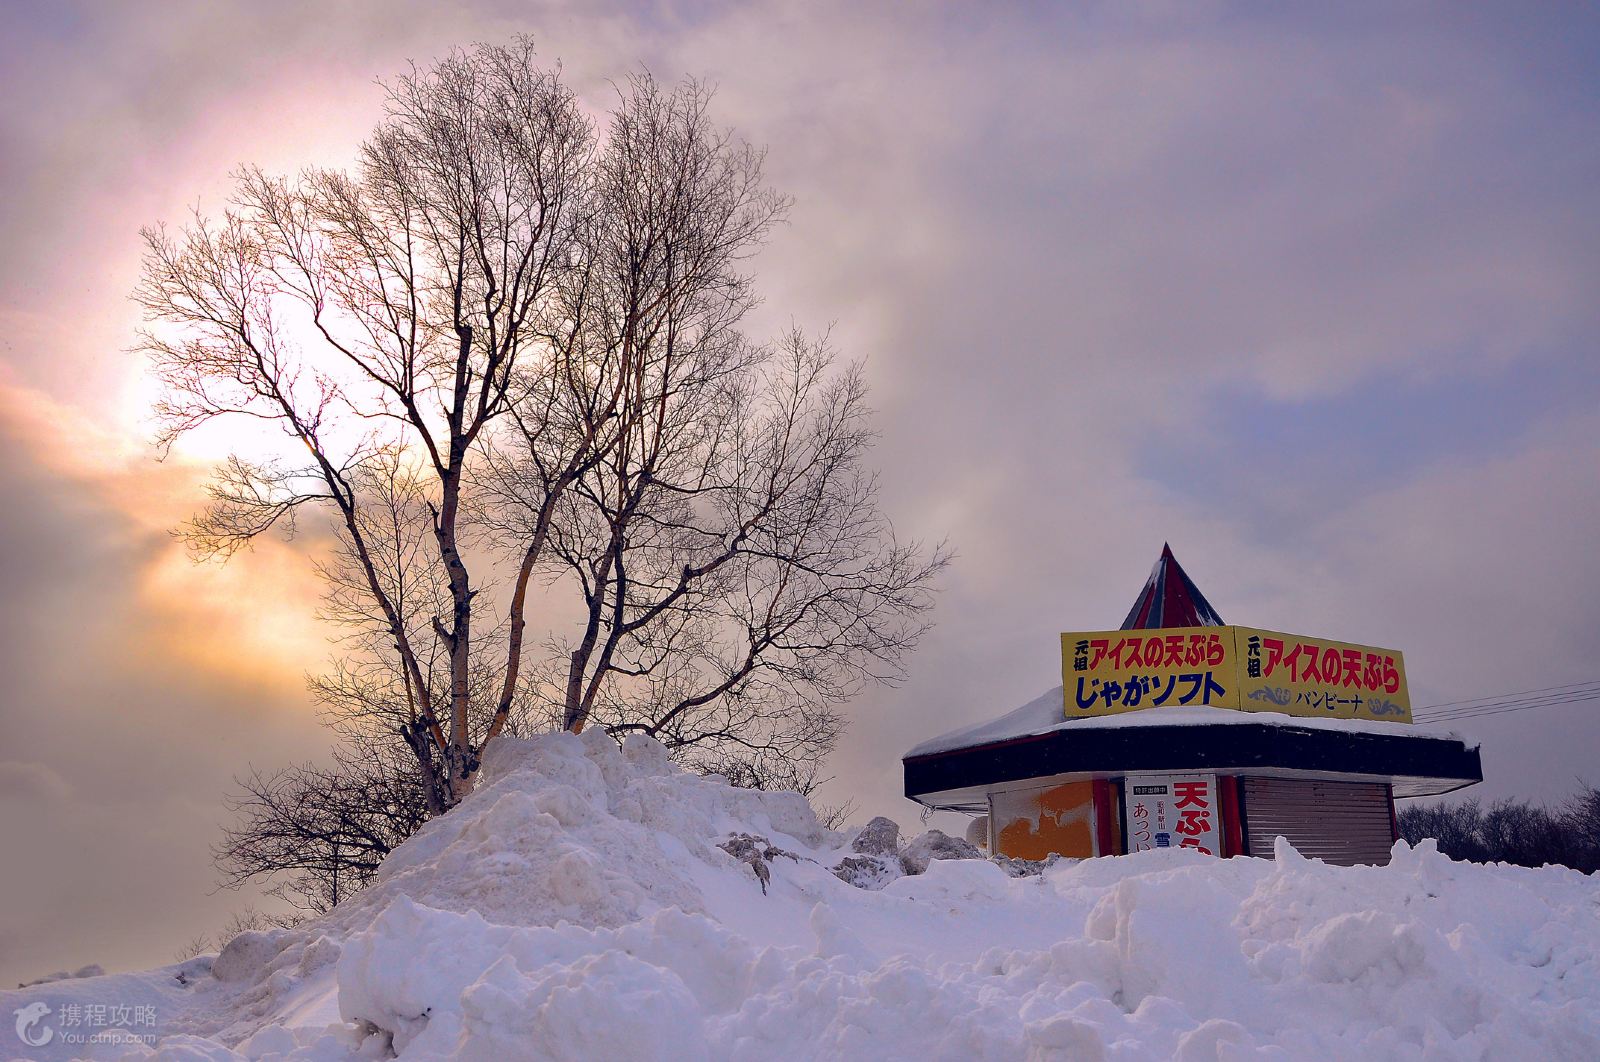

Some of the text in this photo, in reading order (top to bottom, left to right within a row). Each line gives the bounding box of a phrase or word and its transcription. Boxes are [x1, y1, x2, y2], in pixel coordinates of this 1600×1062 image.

[1073, 639, 1088, 672] 元祖
[1089, 634, 1225, 670] アイスの天ぷら
[1248, 635, 1261, 679] 元祖
[1262, 638, 1400, 695] アイスの天ぷら
[1075, 671, 1226, 709] じゃがソフト
[1296, 692, 1364, 712] バンビーナ
